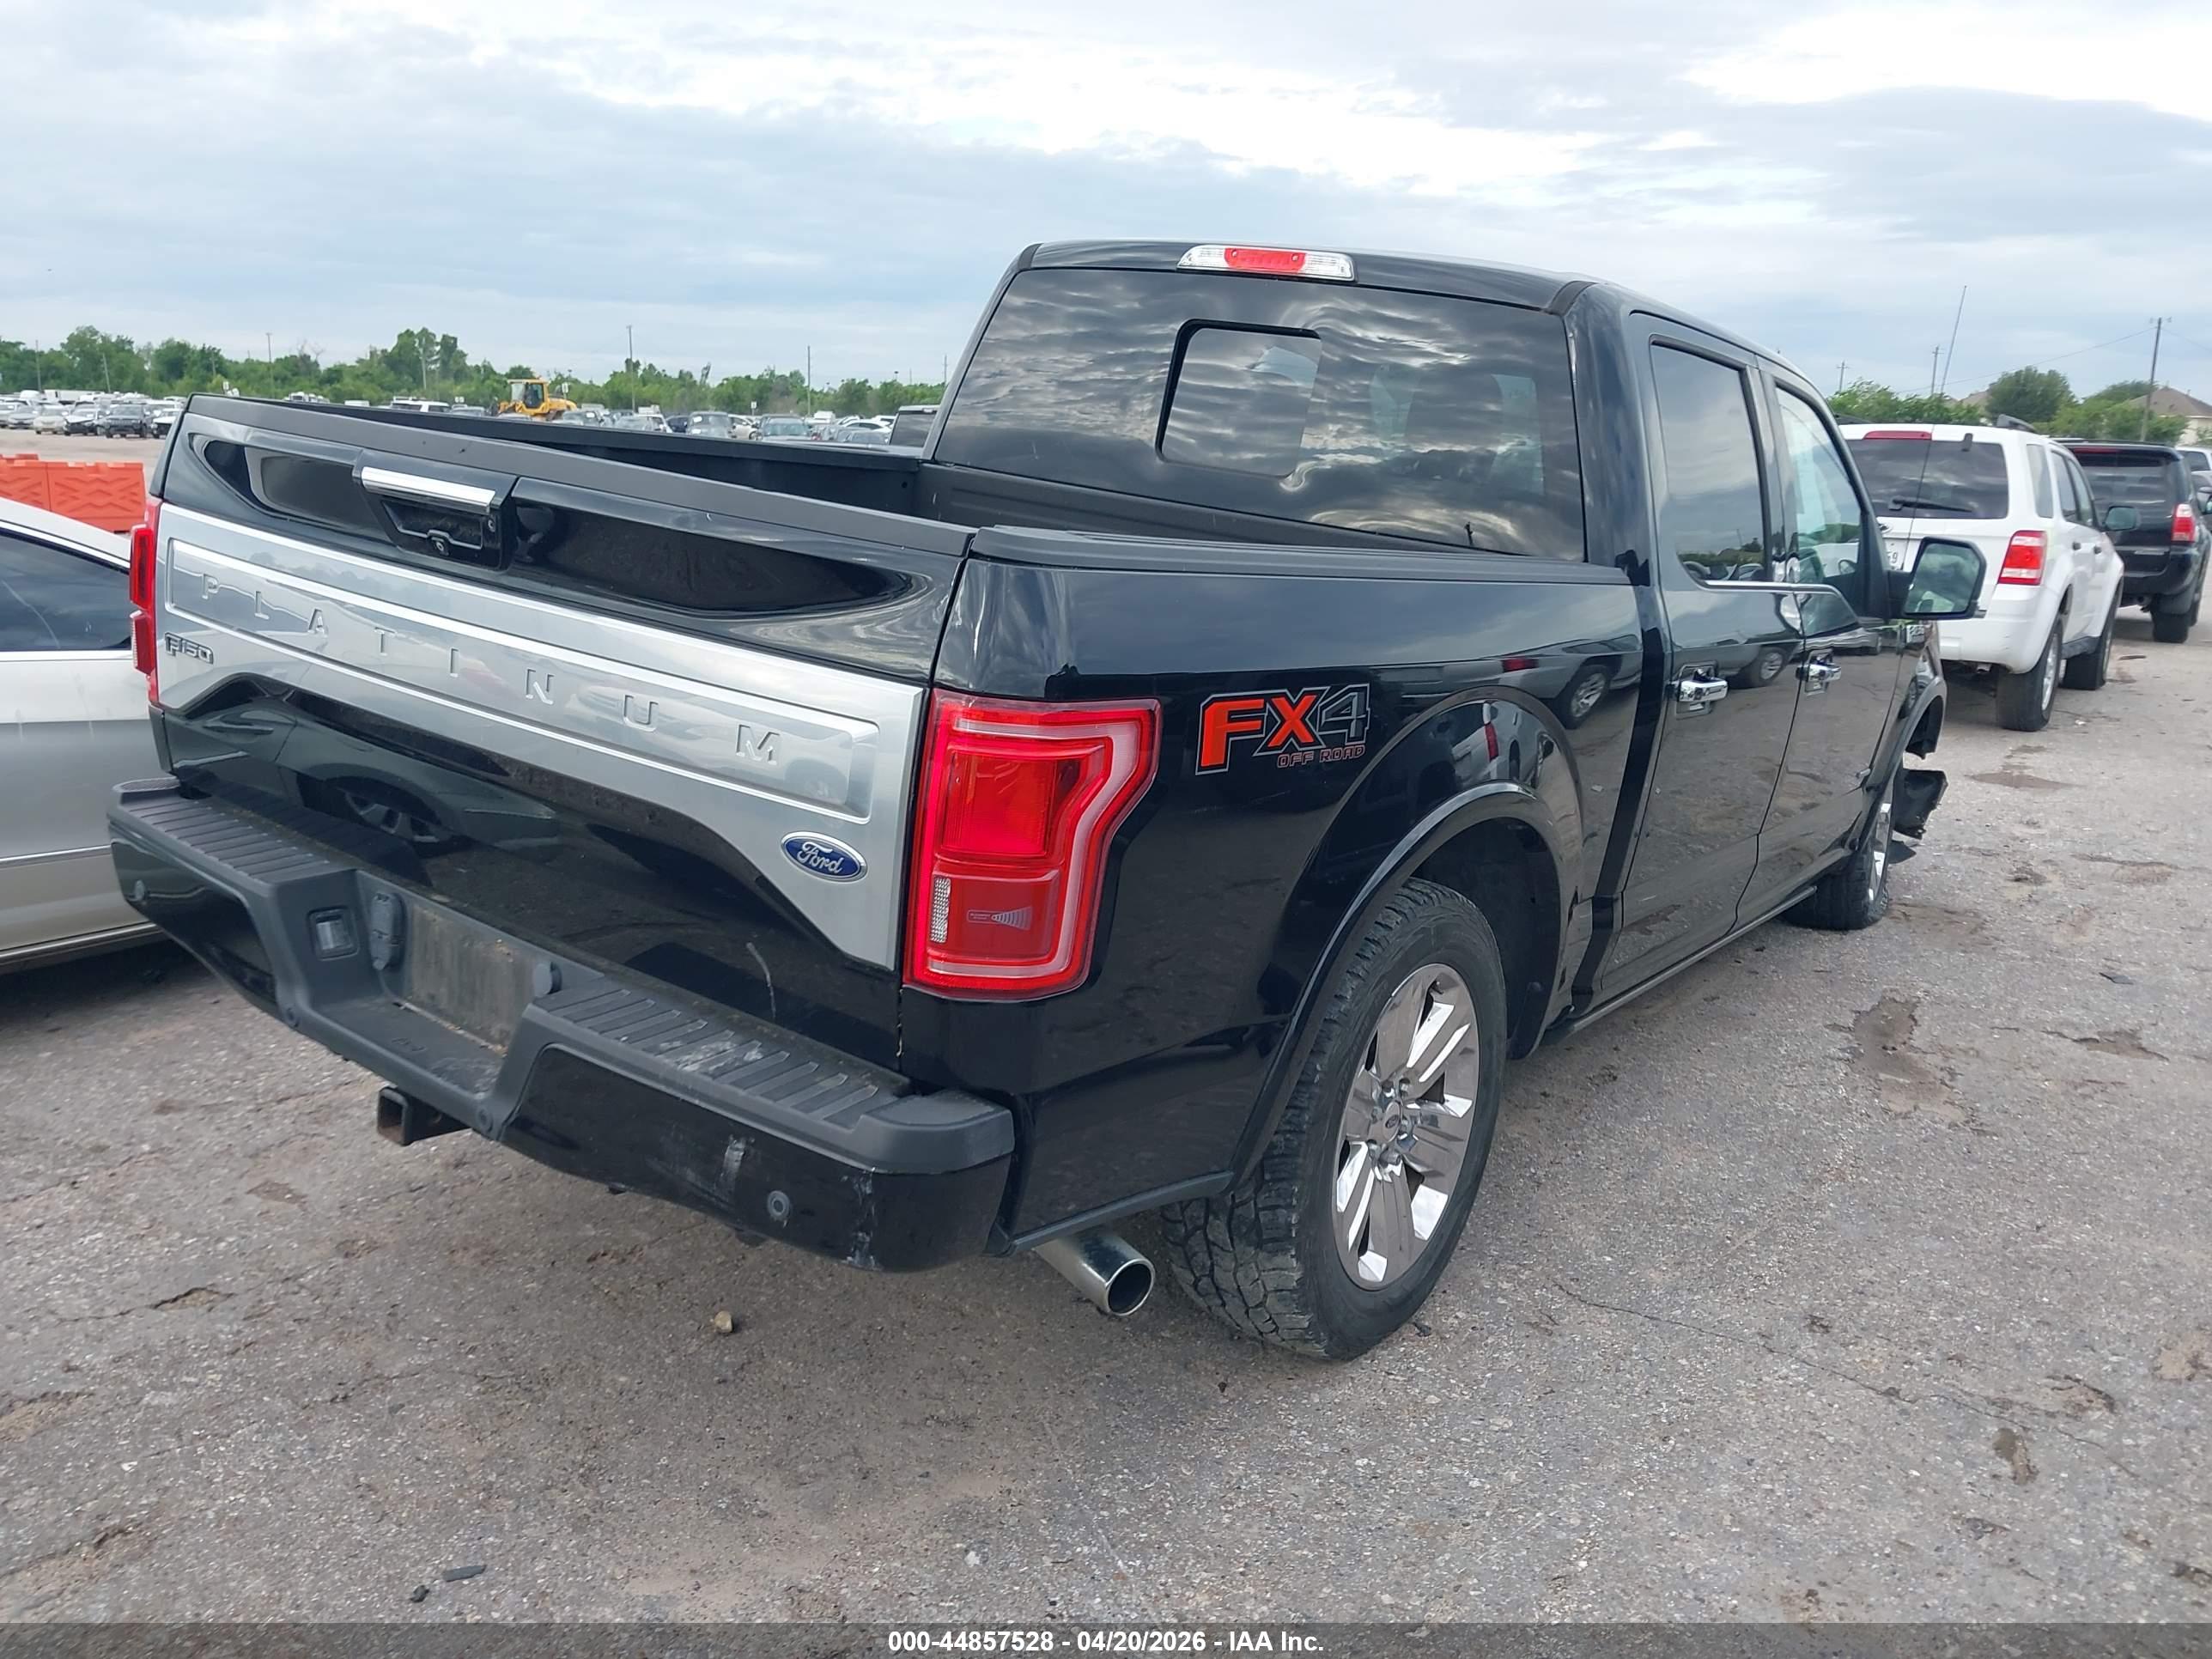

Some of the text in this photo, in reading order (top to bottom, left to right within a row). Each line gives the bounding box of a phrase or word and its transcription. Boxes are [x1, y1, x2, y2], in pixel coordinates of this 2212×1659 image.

[203, 574, 780, 765] PLATINUM
[1195, 683, 1370, 775] FX4
[1277, 744, 1365, 768] OFF ROAD
[796, 841, 845, 873] Ford
